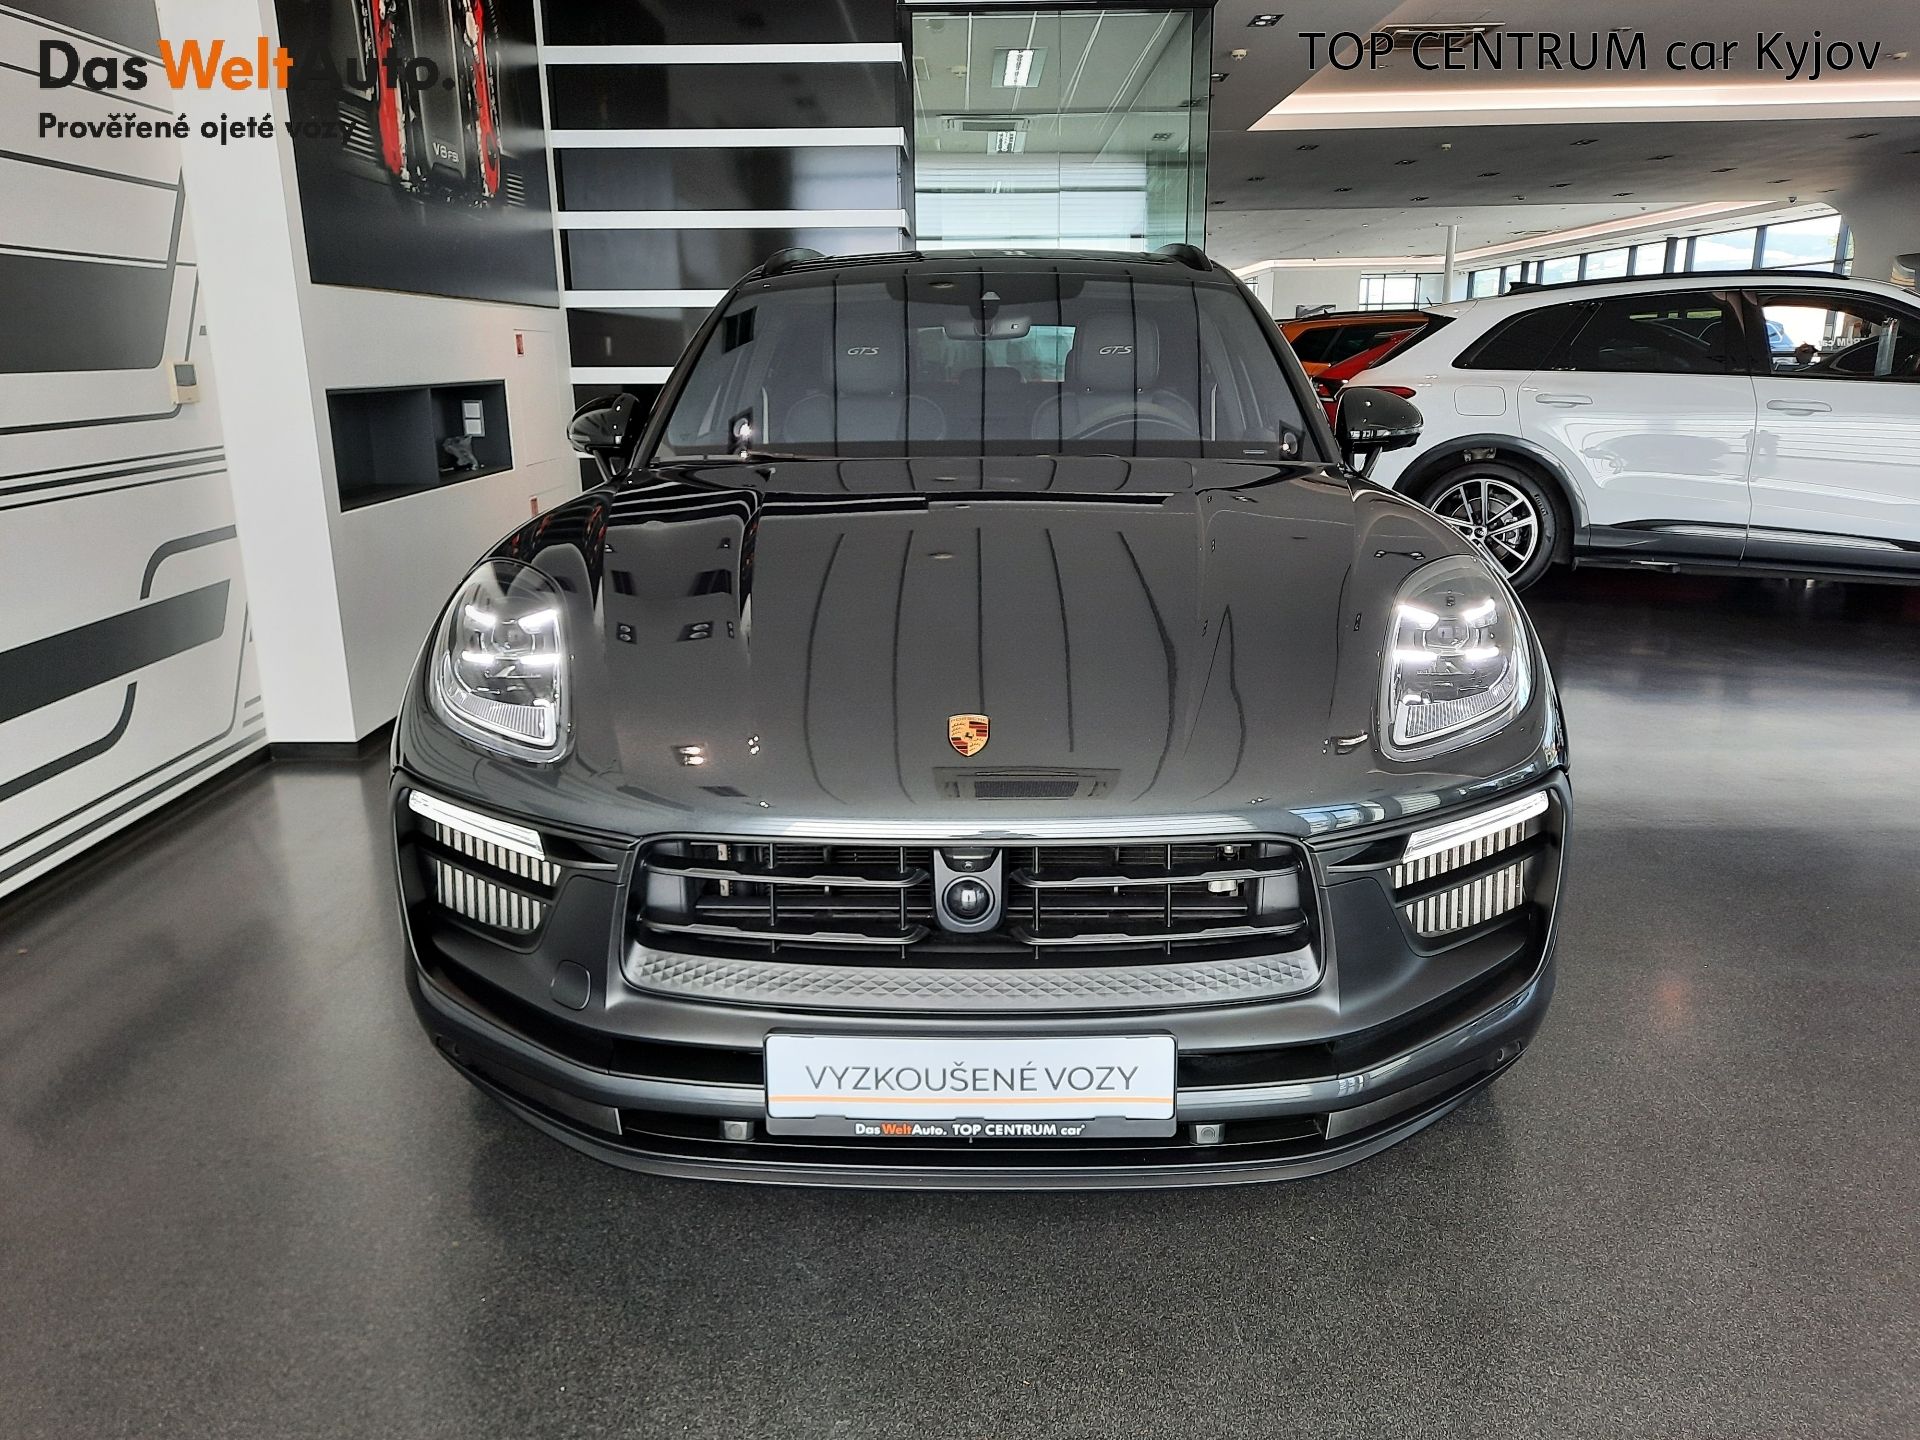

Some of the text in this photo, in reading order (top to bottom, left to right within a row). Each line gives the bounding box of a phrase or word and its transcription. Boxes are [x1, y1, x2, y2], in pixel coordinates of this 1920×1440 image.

[847, 347, 880, 355] GTS
[1099, 345, 1133, 355] GTS
[805, 1060, 1139, 1092] VYZKOUŠENÉ VOZY
[855, 1123, 881, 1136] Das
[952, 1124, 982, 1136] TOP
[984, 1123, 1057, 1137] CENTRUM
